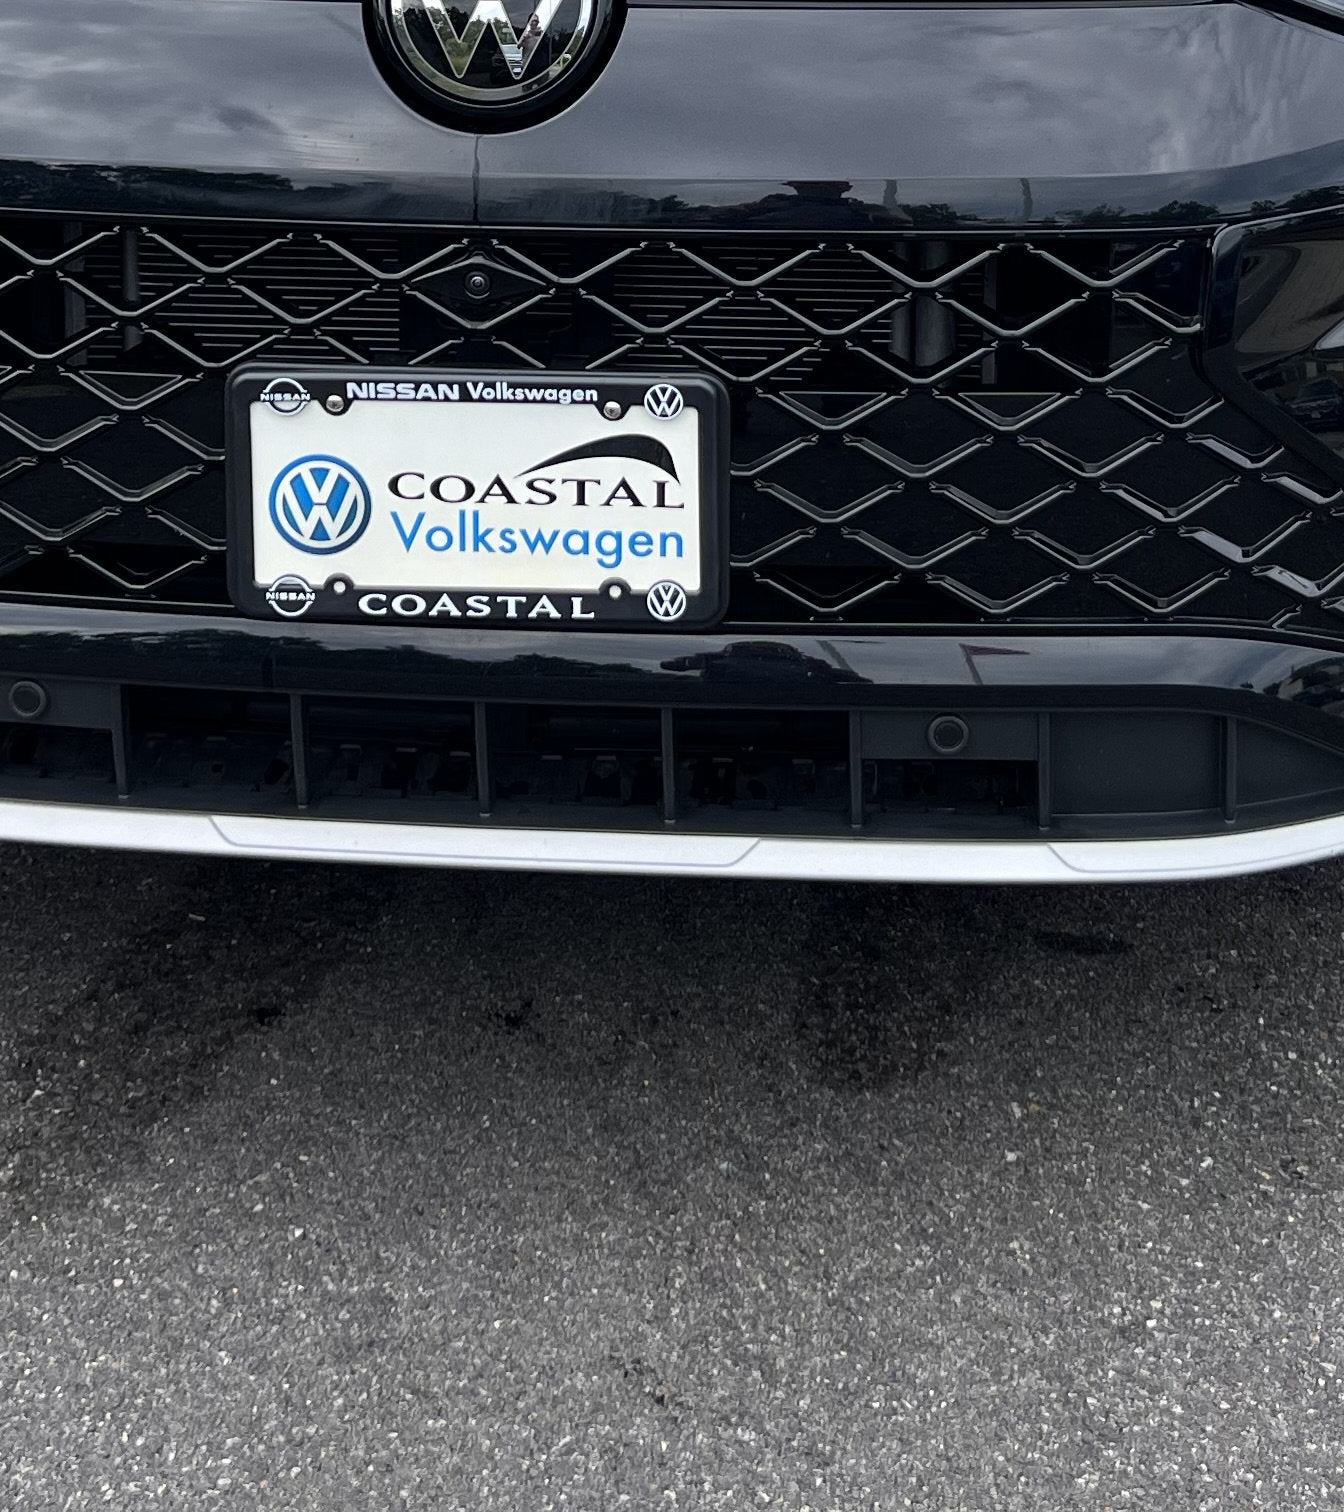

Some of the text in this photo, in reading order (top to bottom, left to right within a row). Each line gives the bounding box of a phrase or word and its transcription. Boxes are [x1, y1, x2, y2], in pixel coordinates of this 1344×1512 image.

[260, 392, 311, 401] NISSAN
[346, 381, 599, 405] NISSAN Volkswagen
[387, 472, 685, 509] COASTAL
[390, 509, 684, 569] Volkswagen
[265, 591, 316, 601] NISSAN
[358, 592, 596, 620] COASTAL
